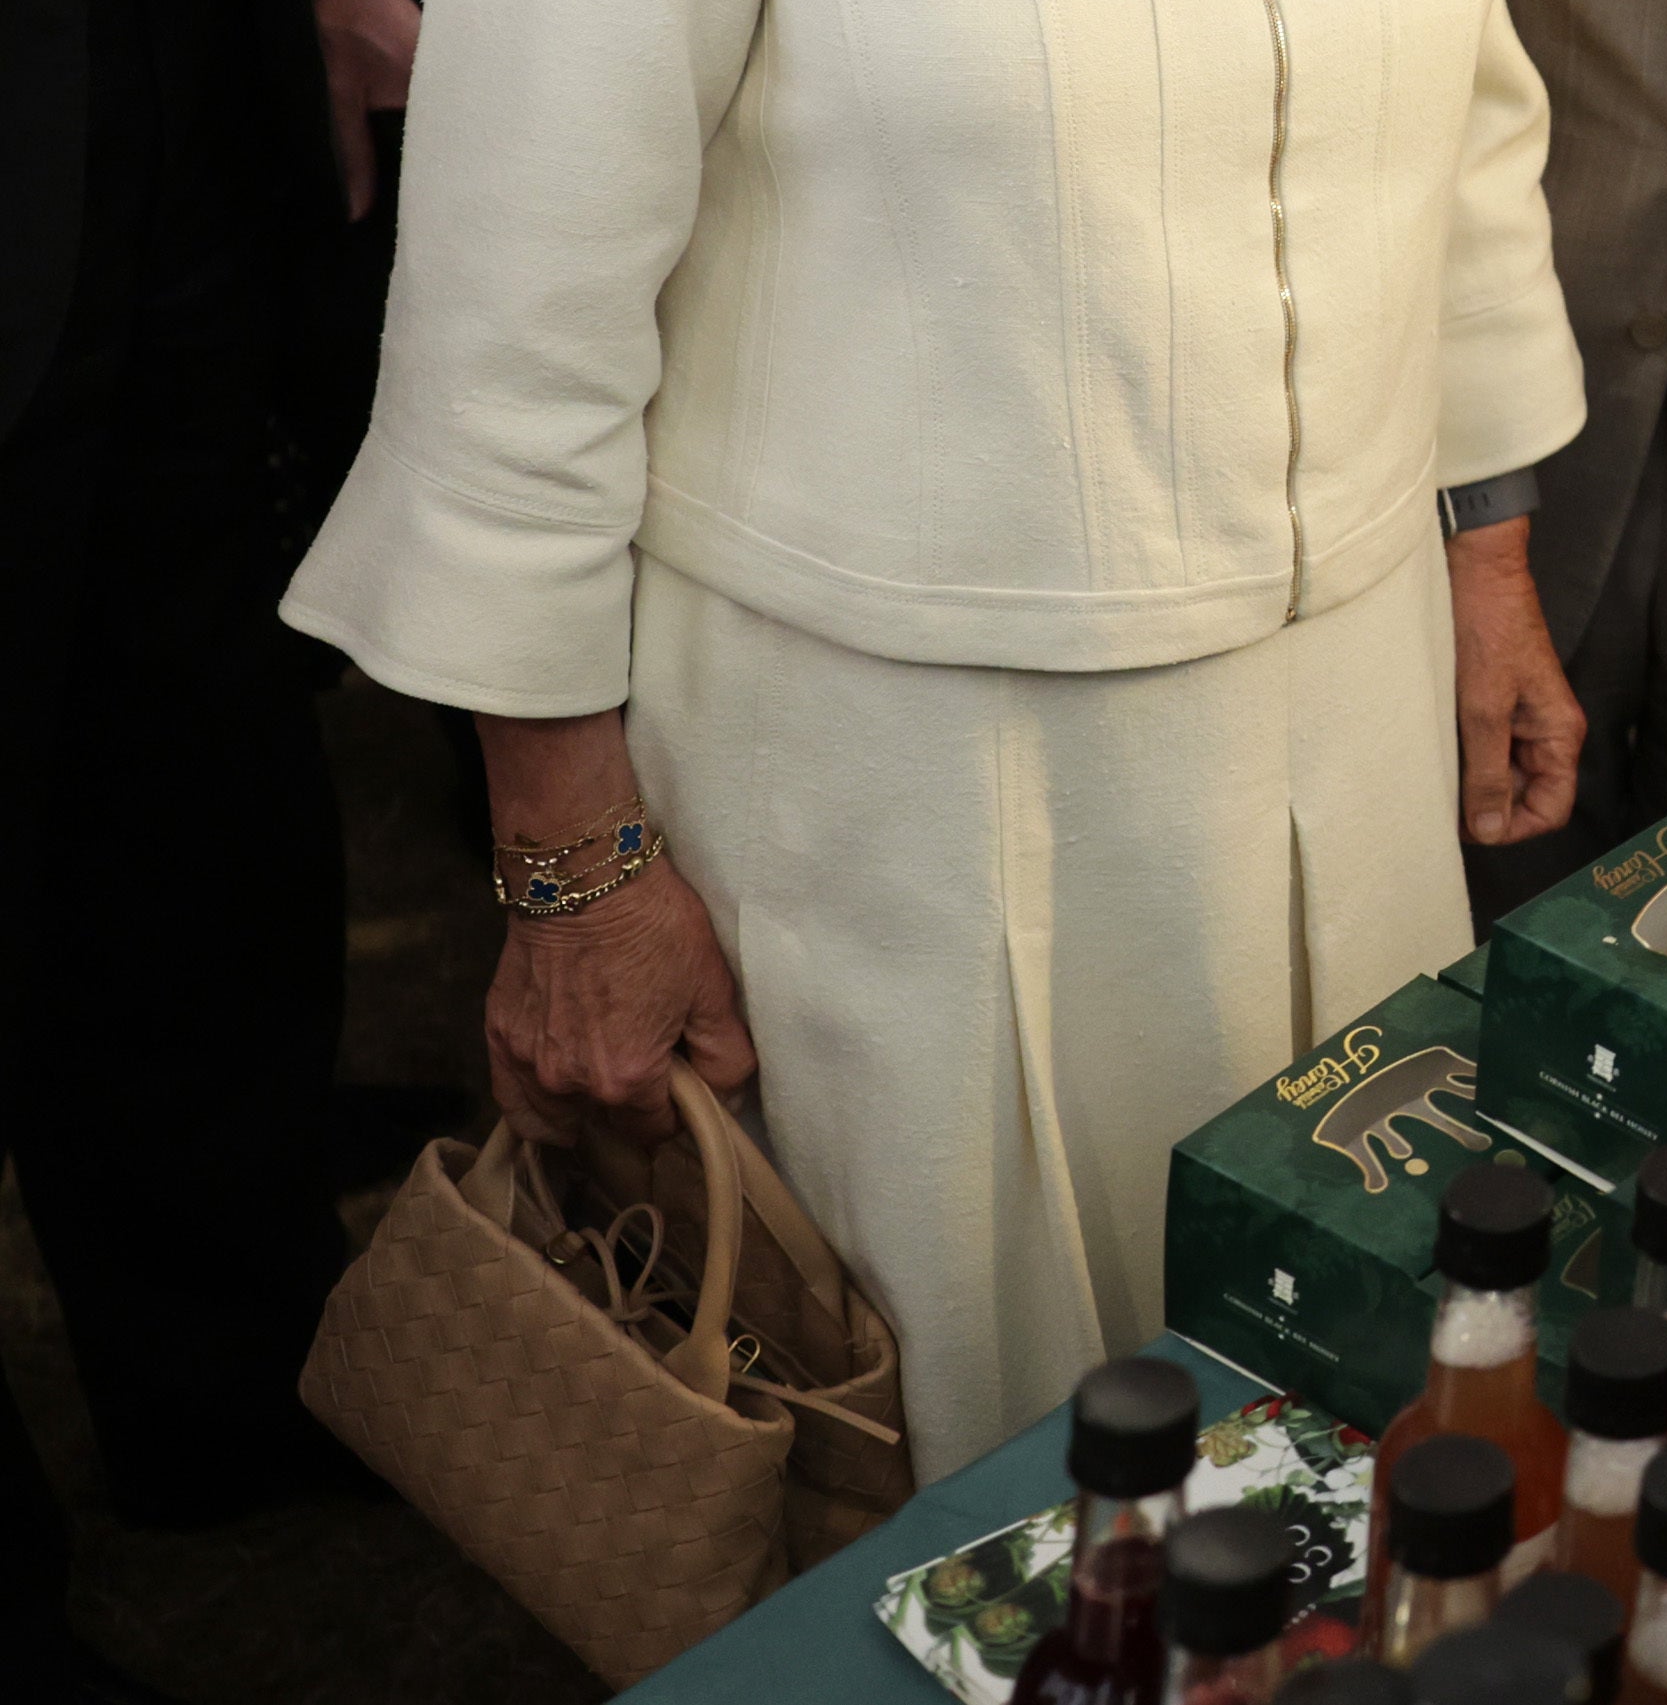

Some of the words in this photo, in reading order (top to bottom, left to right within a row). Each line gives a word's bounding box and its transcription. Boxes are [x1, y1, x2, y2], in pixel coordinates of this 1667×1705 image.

[1276, 1025, 1383, 1101] Honey
[1539, 1070, 1579, 1098] CORNISH
[1581, 1093, 1607, 1114] BLACK
[1610, 1109, 1624, 1122] BEE
[1626, 1118, 1658, 1141] HONEY
[1223, 1292, 1263, 1319] CORNISH
[1264, 1316, 1290, 1335] BLACK
[1309, 1341, 1340, 1363] HONEY
